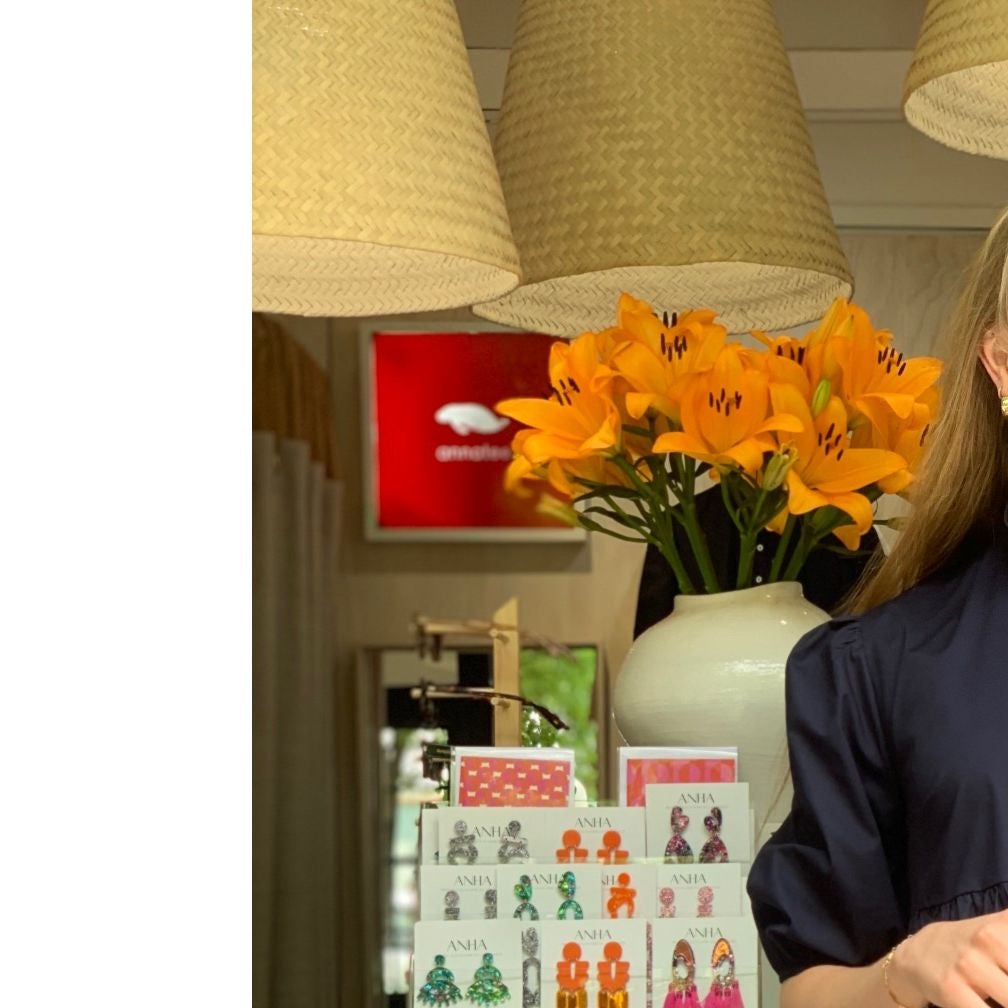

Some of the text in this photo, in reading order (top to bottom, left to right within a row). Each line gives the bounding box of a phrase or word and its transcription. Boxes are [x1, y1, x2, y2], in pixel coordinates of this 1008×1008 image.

[679, 792, 715, 804] ANHA
[575, 816, 612, 828] ANHA
[455, 874, 492, 886] ANHA
[671, 873, 708, 885] ANHA
[575, 928, 613, 940] ANHA
[685, 927, 724, 938] ANHA
[447, 939, 488, 951] ANHA
